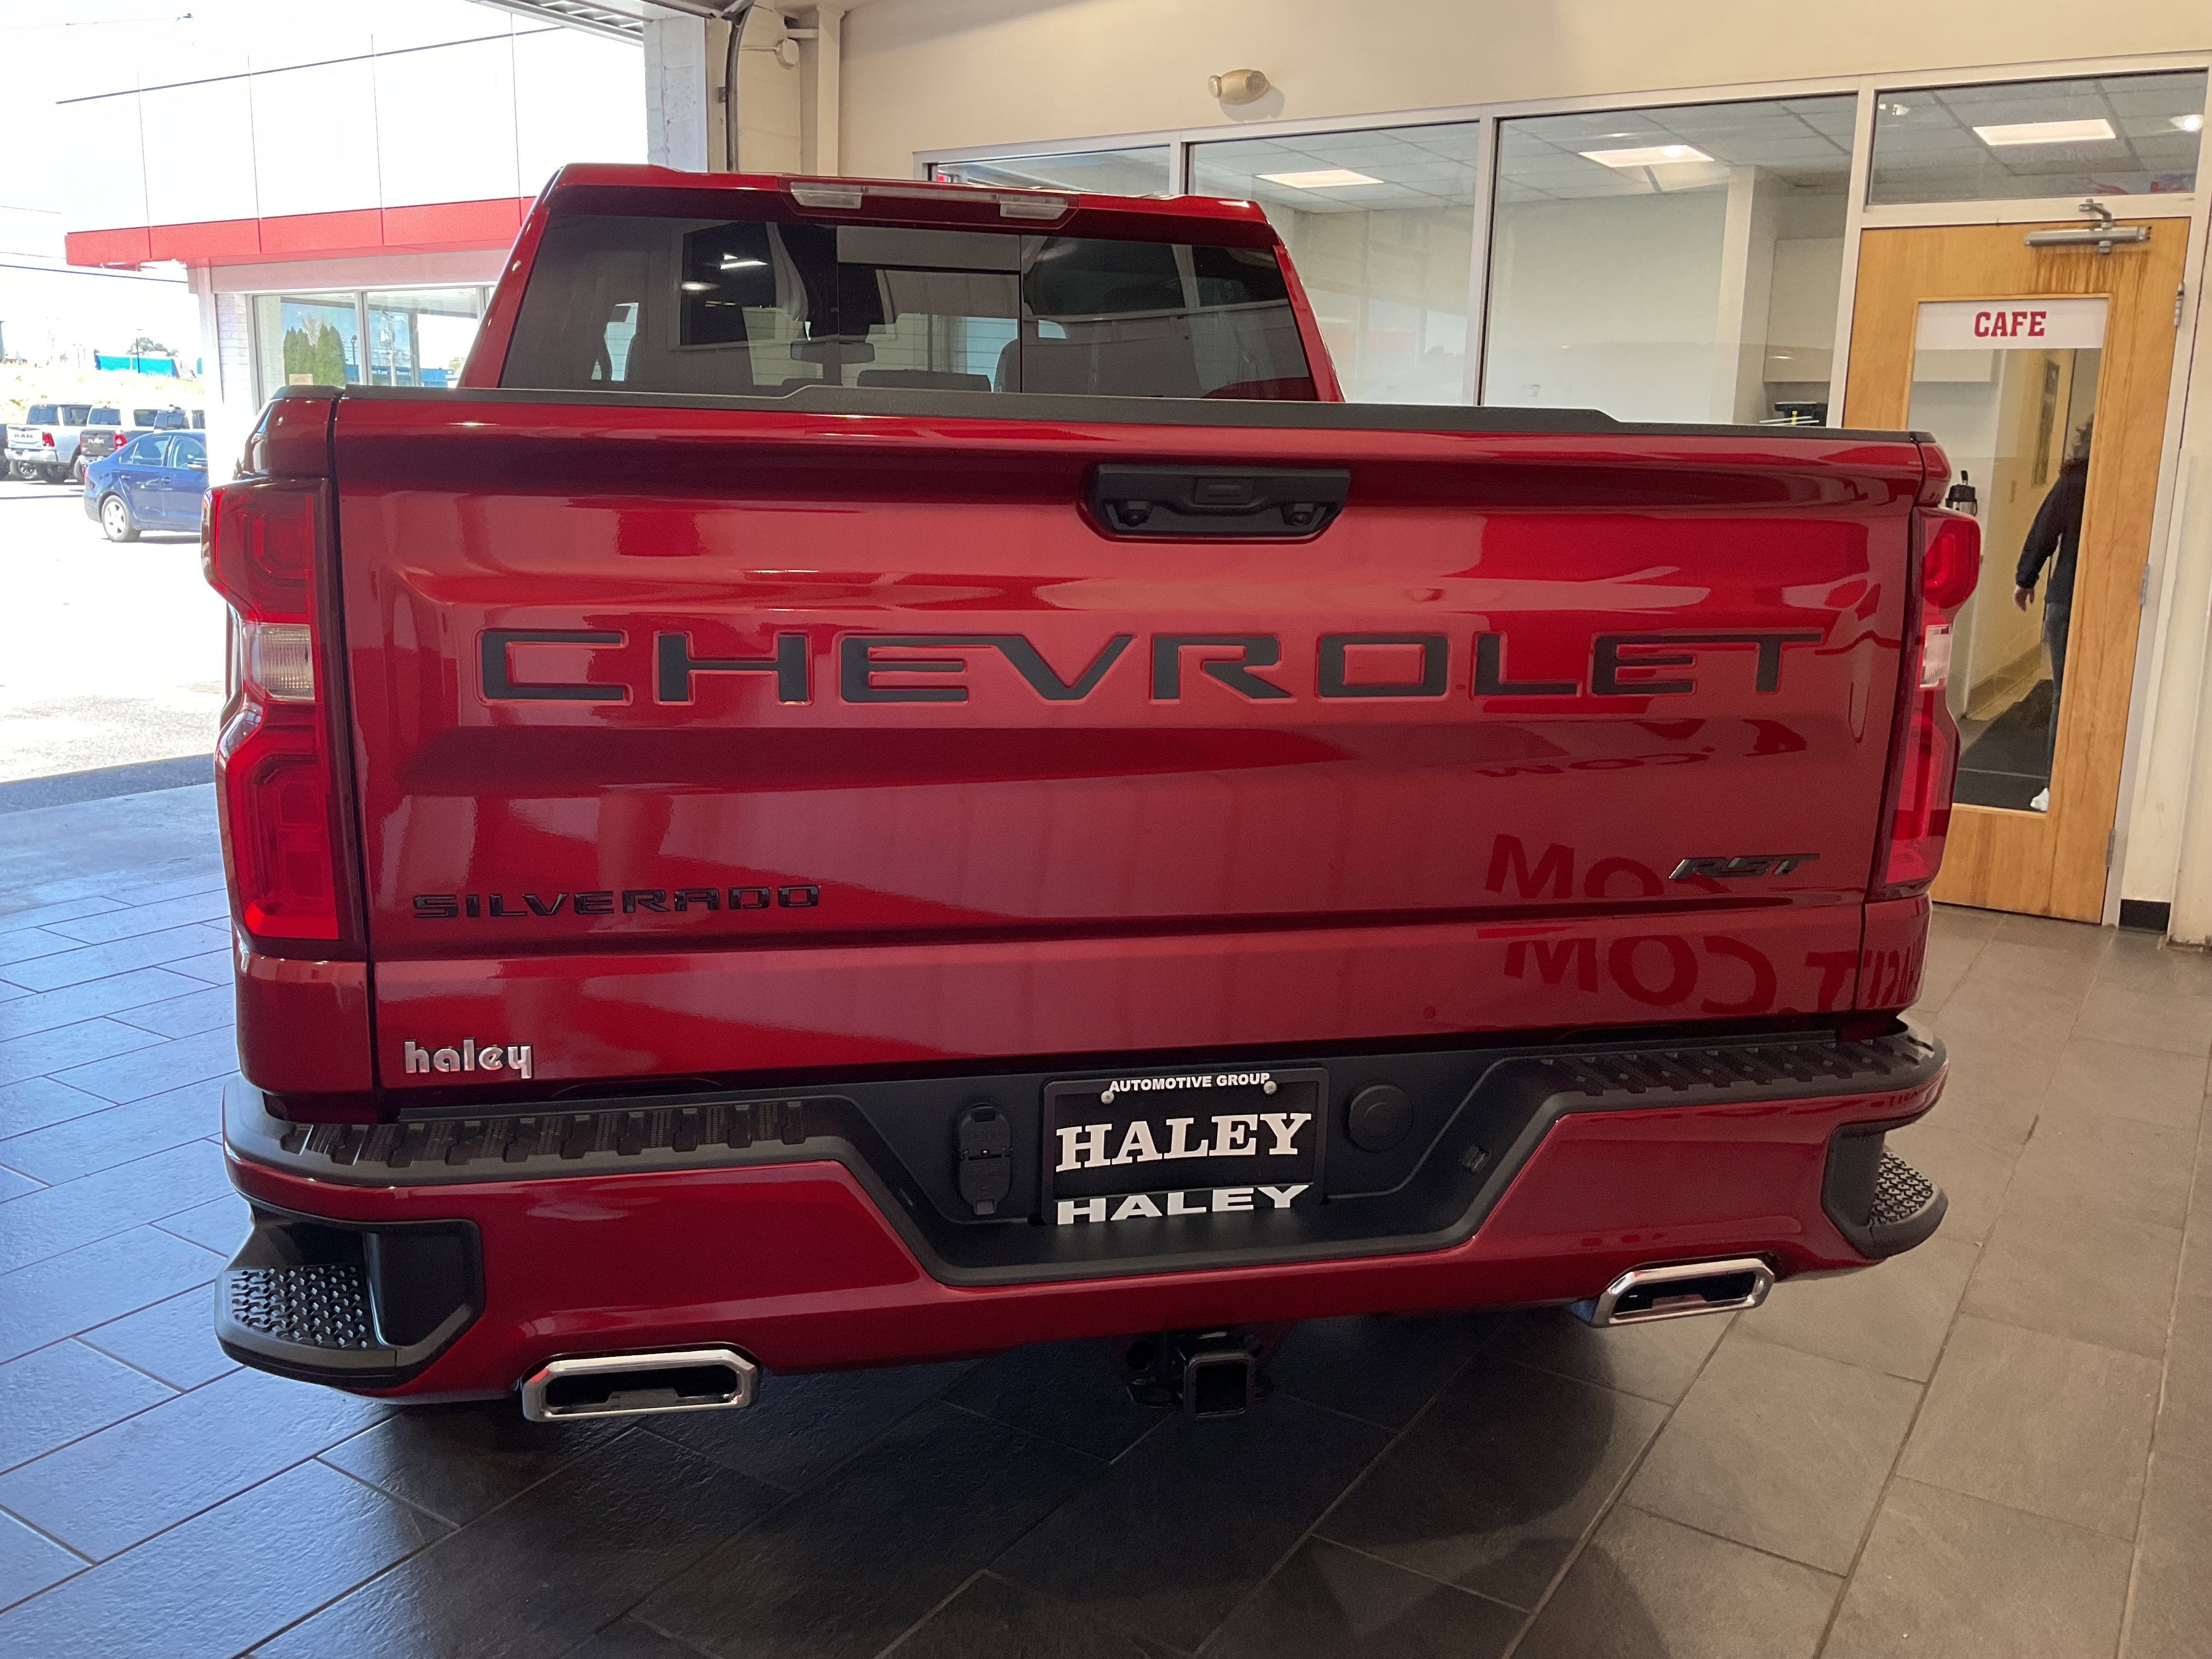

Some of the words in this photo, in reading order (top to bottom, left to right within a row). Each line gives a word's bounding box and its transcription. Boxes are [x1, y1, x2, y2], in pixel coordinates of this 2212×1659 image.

[1974, 311, 2047, 337] CAFE
[478, 629, 1822, 707] CHEVROLET
[1668, 853, 1820, 879] RST
[413, 884, 821, 919] SILVERADO
[404, 1038, 532, 1079] haley
[1108, 1076, 1212, 1093] AUTOMOTIVE
[1216, 1073, 1270, 1087] GROUP
[1055, 1113, 1312, 1172] HALEY
[1057, 1184, 1310, 1225] HALEY
